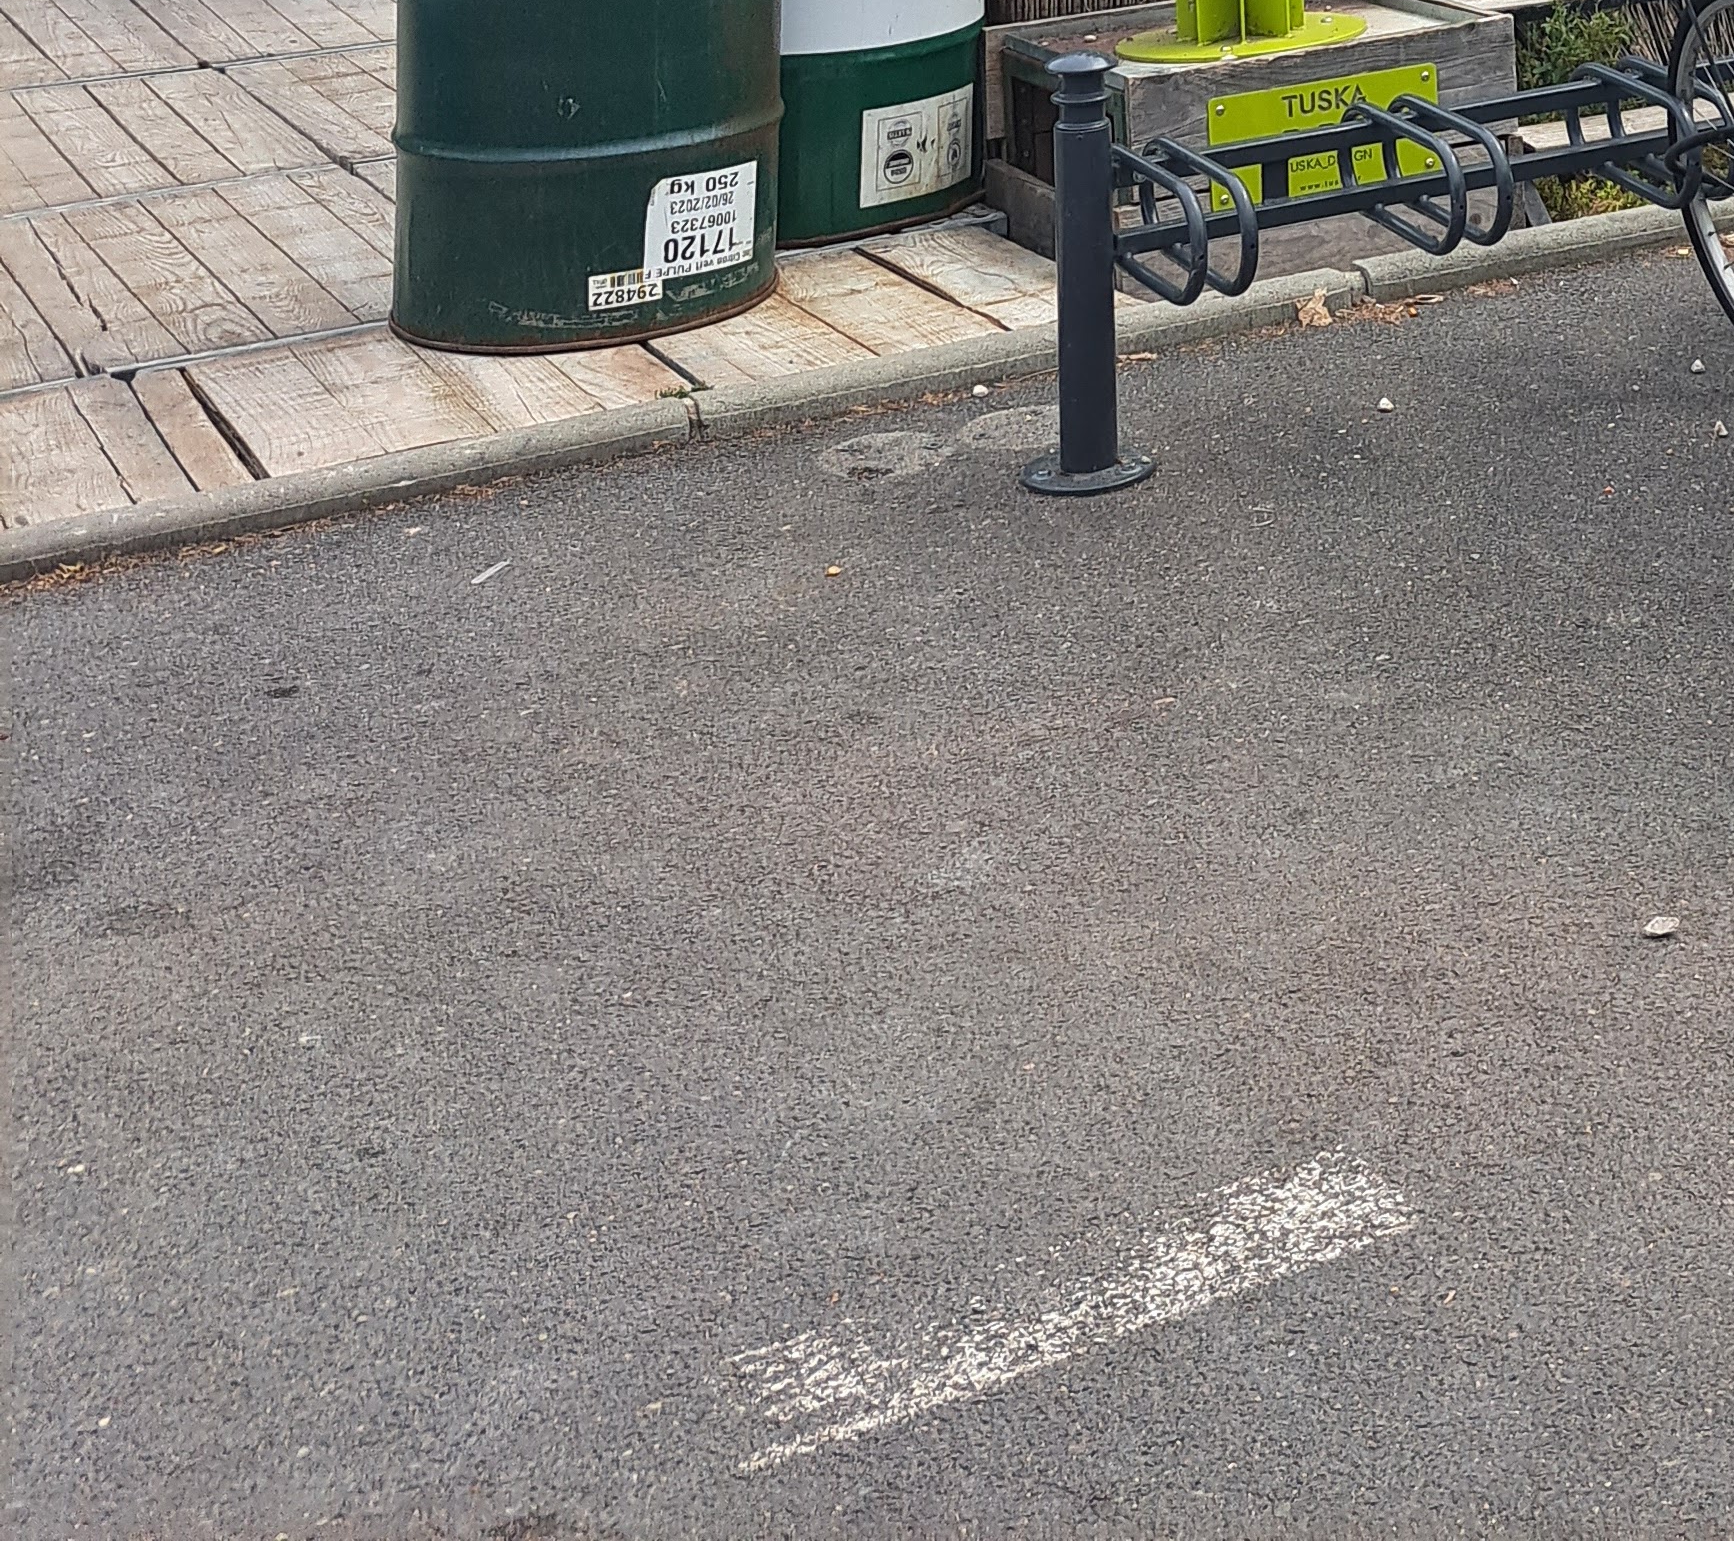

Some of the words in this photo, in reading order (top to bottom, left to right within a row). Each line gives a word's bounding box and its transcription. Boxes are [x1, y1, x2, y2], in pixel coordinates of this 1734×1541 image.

[1281, 84, 1367, 118] TUSKA
[669, 179, 696, 196] kg
[704, 171, 740, 193] 250
[669, 190, 735, 216] 26/02/2023
[670, 210, 738, 235] 10067323
[662, 227, 738, 265] 17120
[591, 284, 659, 307] 294822
